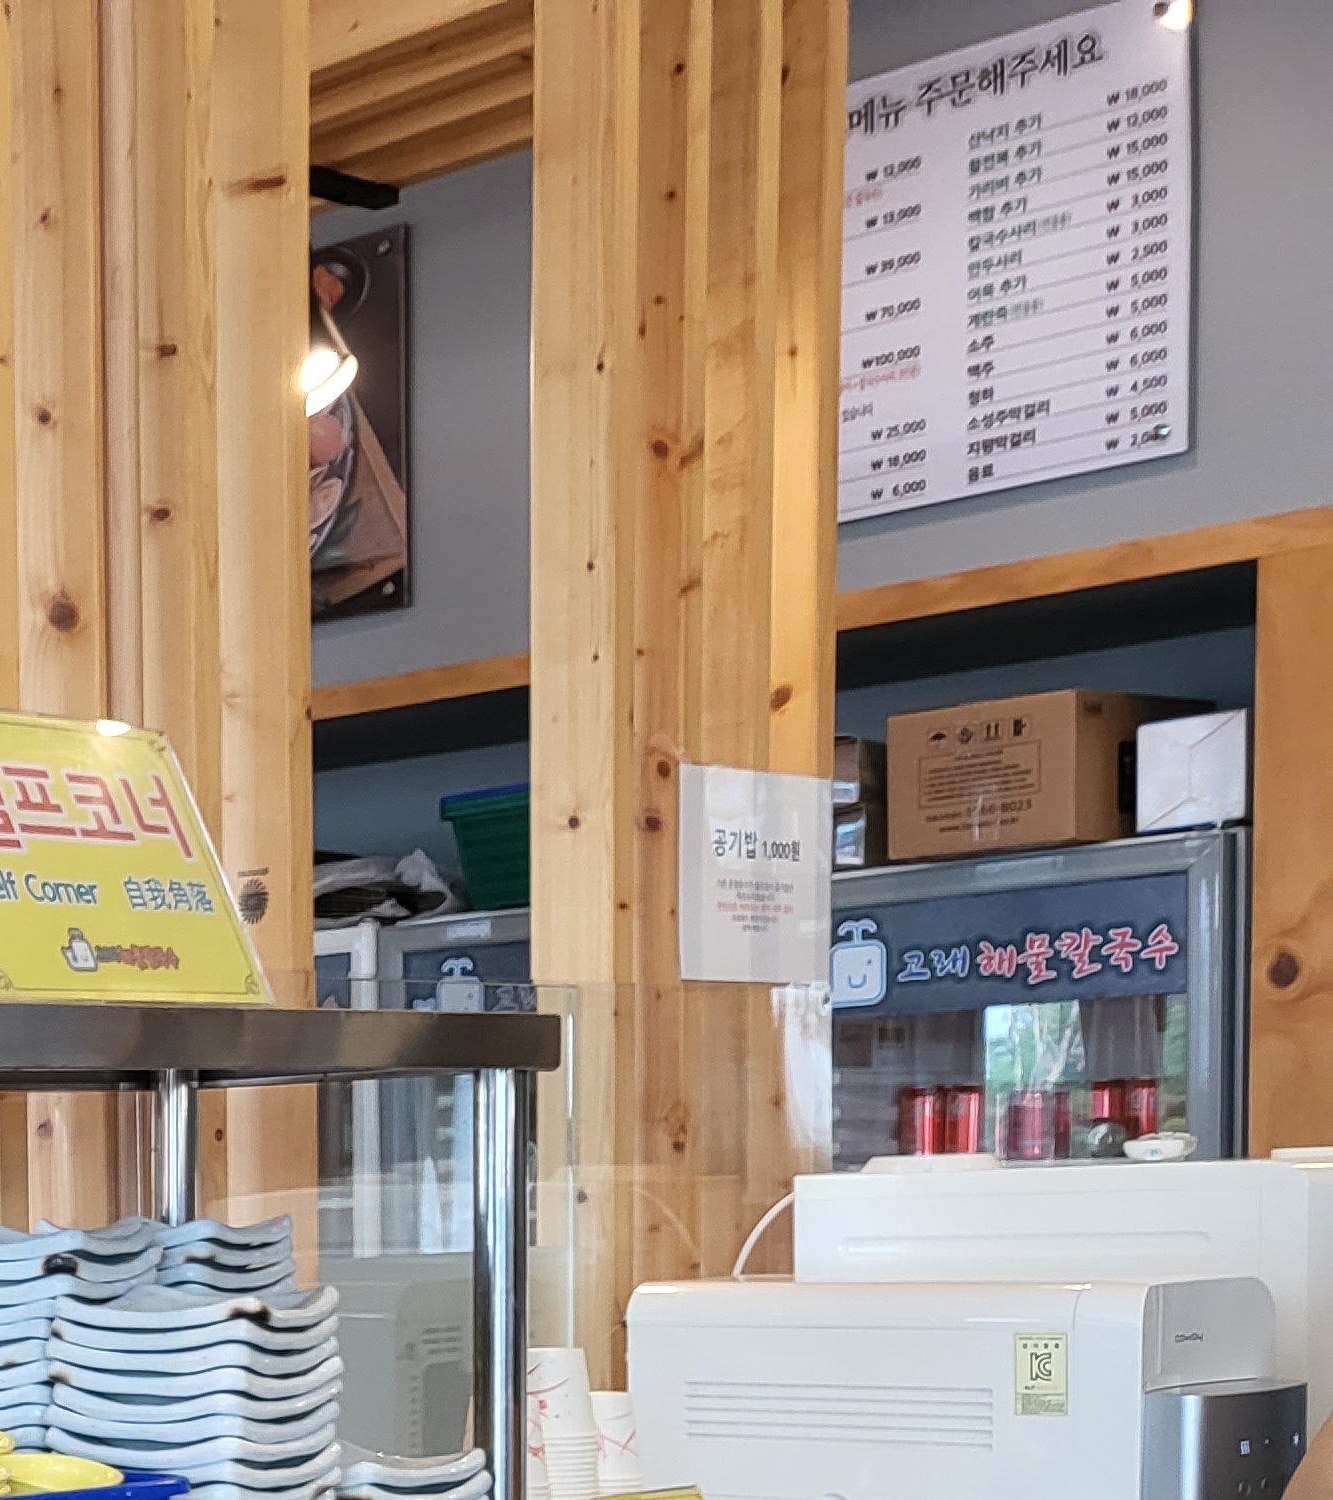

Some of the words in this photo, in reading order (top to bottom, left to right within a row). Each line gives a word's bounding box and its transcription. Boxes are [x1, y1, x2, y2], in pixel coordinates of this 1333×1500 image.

[916, 33, 1104, 116] 주문해주세요
[712, 828, 758, 860] 공기밥
[25, 873, 99, 906] Corner
[123, 876, 214, 913] 自我角落
[897, 945, 970, 982] 고래
[976, 923, 1180, 985] 해물칼국수
